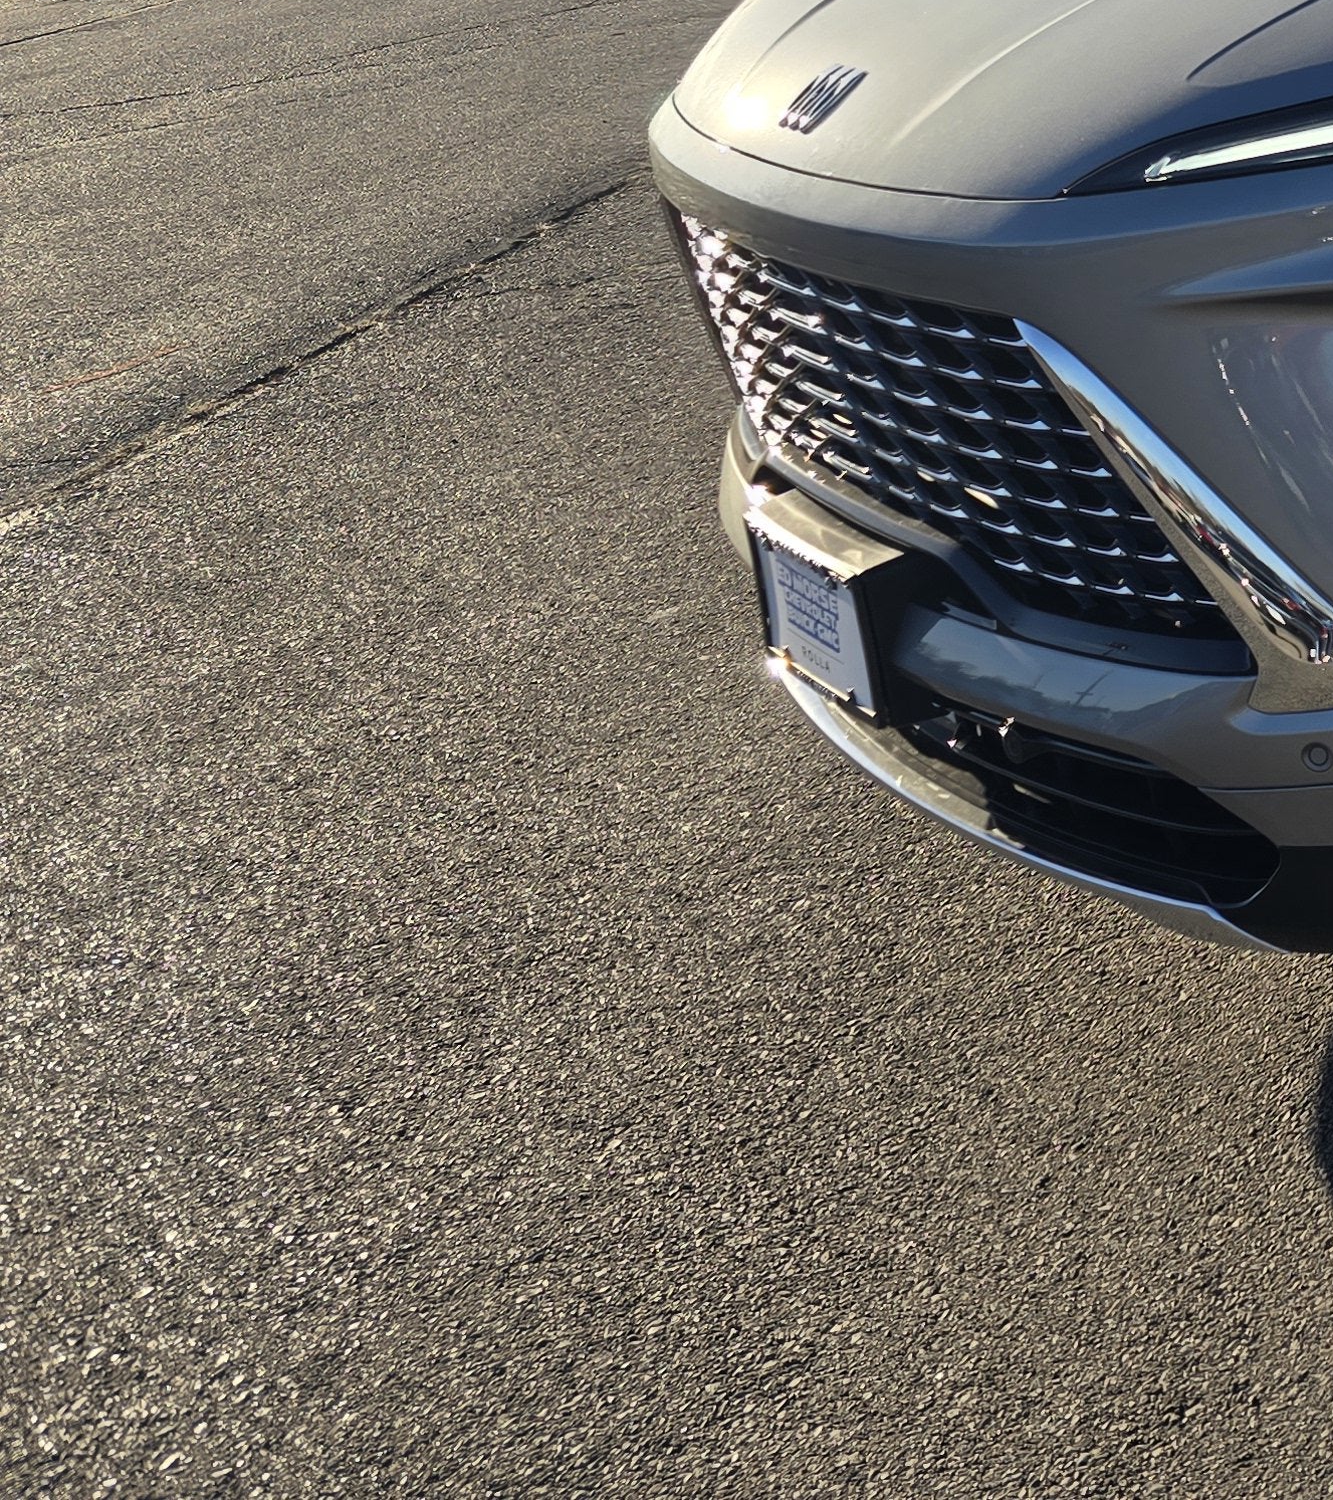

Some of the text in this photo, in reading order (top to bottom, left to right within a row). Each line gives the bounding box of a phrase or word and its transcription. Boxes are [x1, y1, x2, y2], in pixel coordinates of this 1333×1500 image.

[783, 586, 838, 632] CHEVROLET
[791, 570, 839, 616] MORSE
[801, 645, 831, 673] ROLLA
